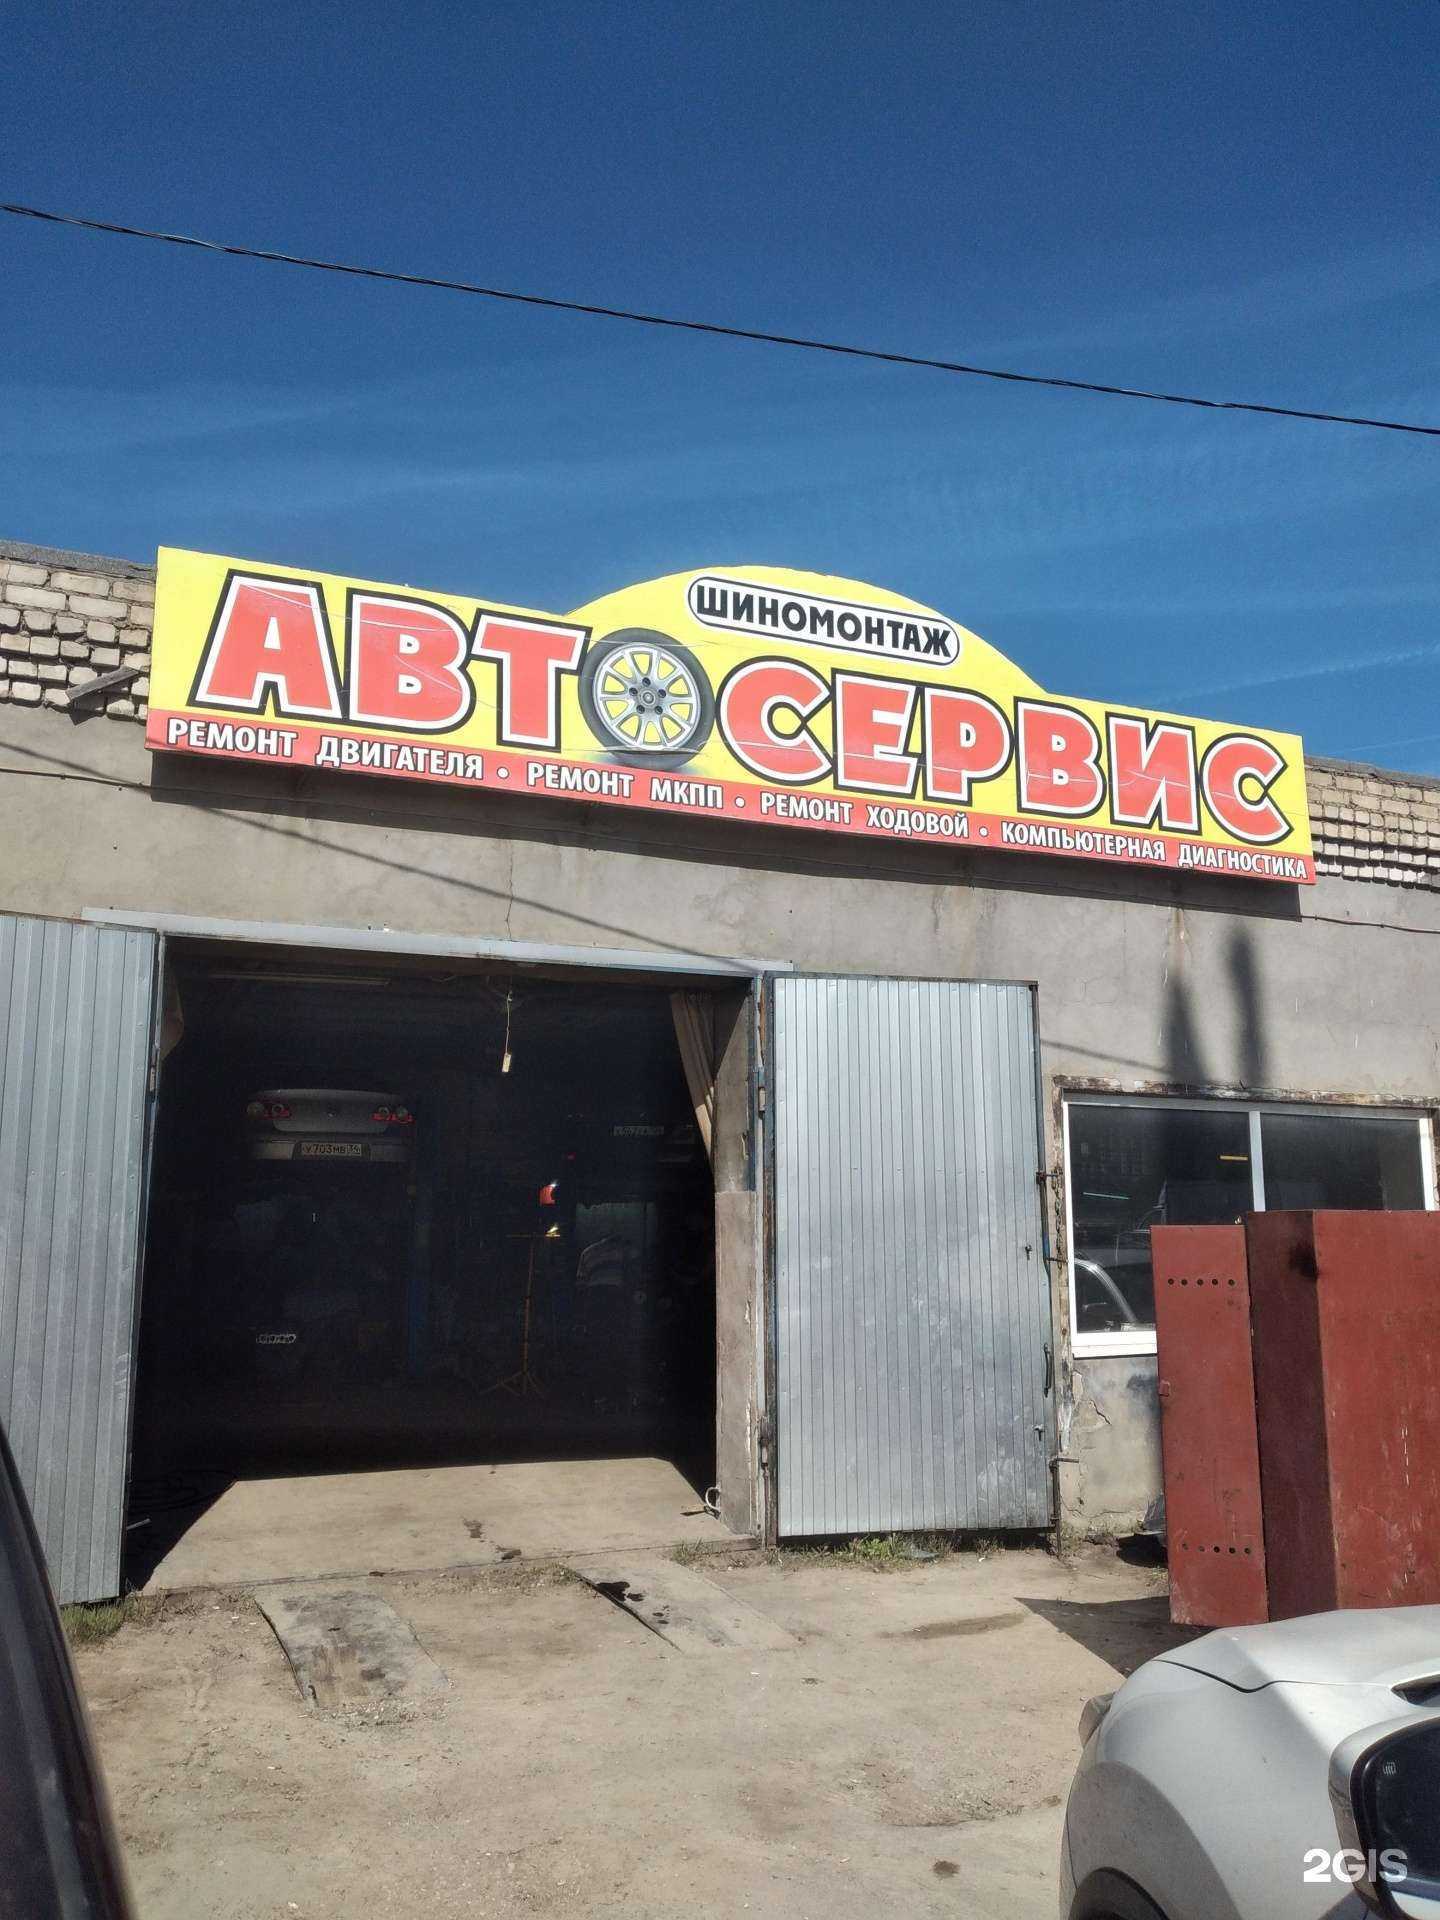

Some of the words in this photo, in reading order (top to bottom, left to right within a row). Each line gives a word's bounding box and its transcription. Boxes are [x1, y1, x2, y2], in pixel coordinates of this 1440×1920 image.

[697, 584, 951, 657] ШИНОМОНТАЖ
[167, 717, 298, 757] РЕМОНТ
[315, 736, 484, 779] ДВИГАТЕЛЯ
[526, 761, 634, 798] РЕМОНТ
[650, 778, 724, 809] МКПП
[760, 792, 853, 825] РЕМОНТ
[866, 804, 968, 838] ХОДОВОЙ
[1001, 821, 1166, 862] КОМПЬЮТЕРНАЯ
[1178, 844, 1308, 880] ДИАГНОСТИКА
